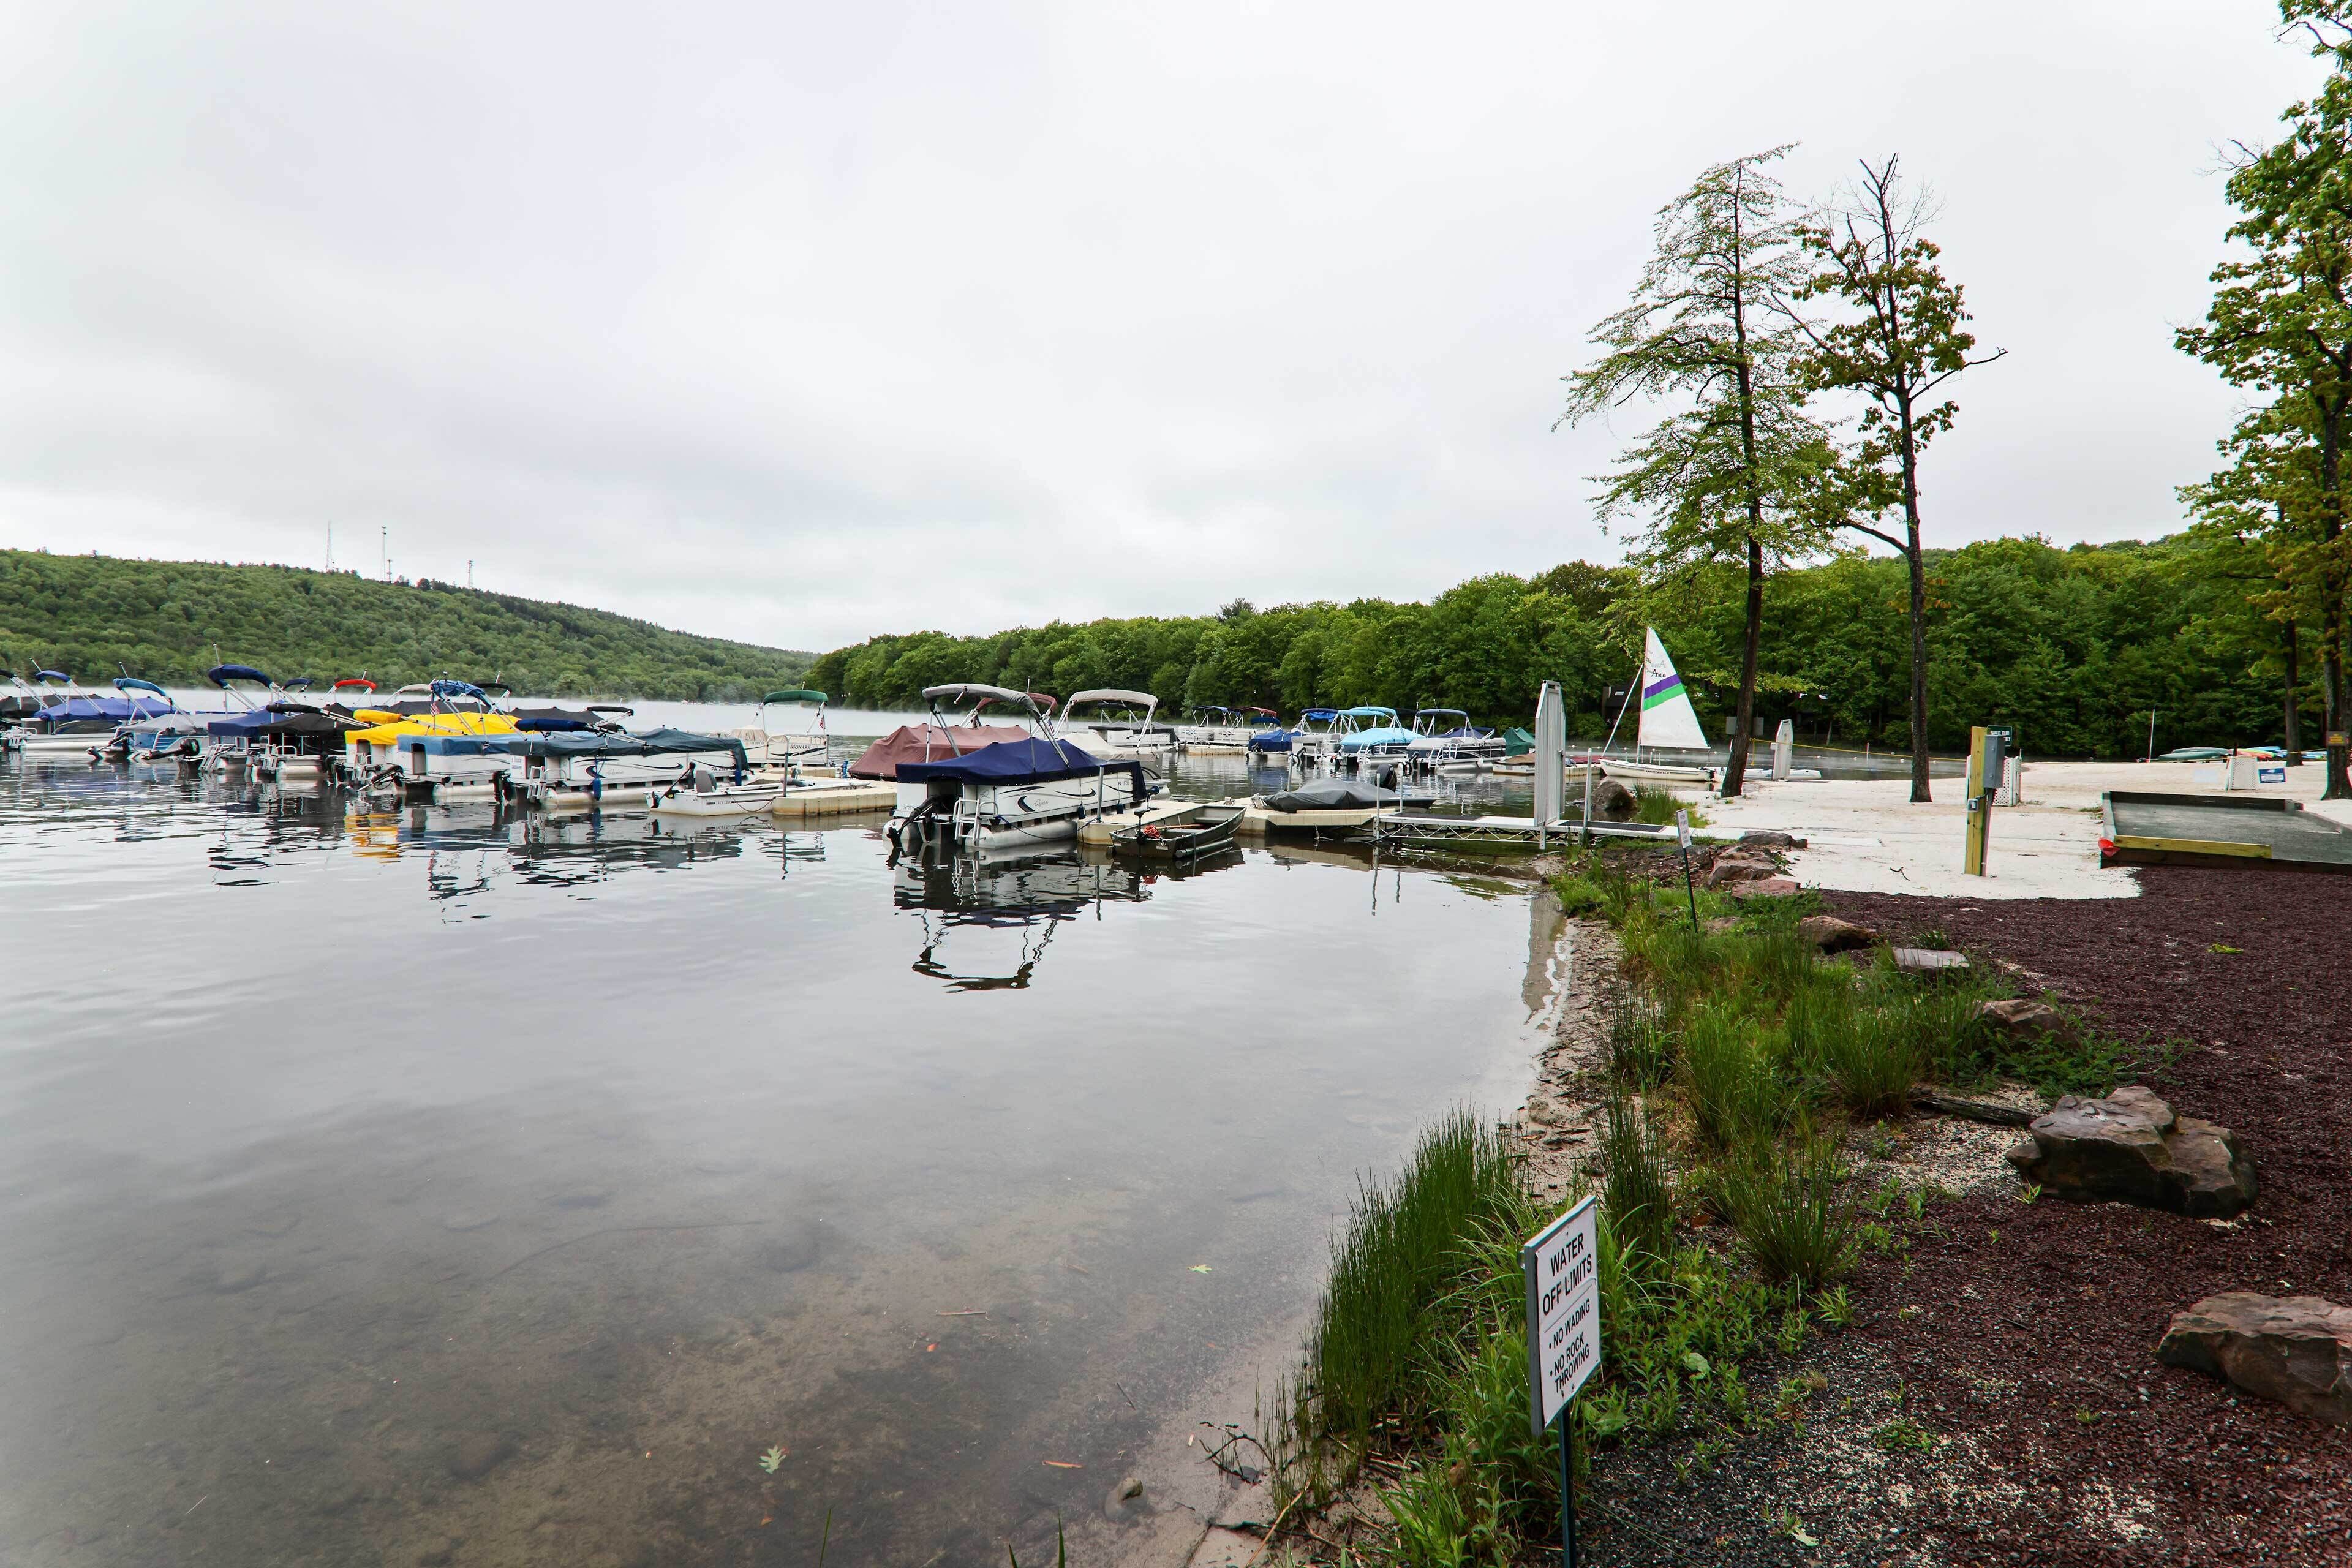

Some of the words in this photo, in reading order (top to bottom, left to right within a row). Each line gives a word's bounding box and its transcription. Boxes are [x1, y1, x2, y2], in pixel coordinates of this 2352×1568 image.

[1550, 1232, 1584, 1277] WATER
[1543, 1281, 1561, 1316] OFF
[1565, 1253, 1592, 1296] LIMITS
[1553, 1327, 1564, 1349] NO
[1564, 1298, 1590, 1336] WADING
[1555, 1354, 1564, 1376] NO
[1566, 1330, 1584, 1363] ROCK
[1555, 1343, 1590, 1393] THROWING
